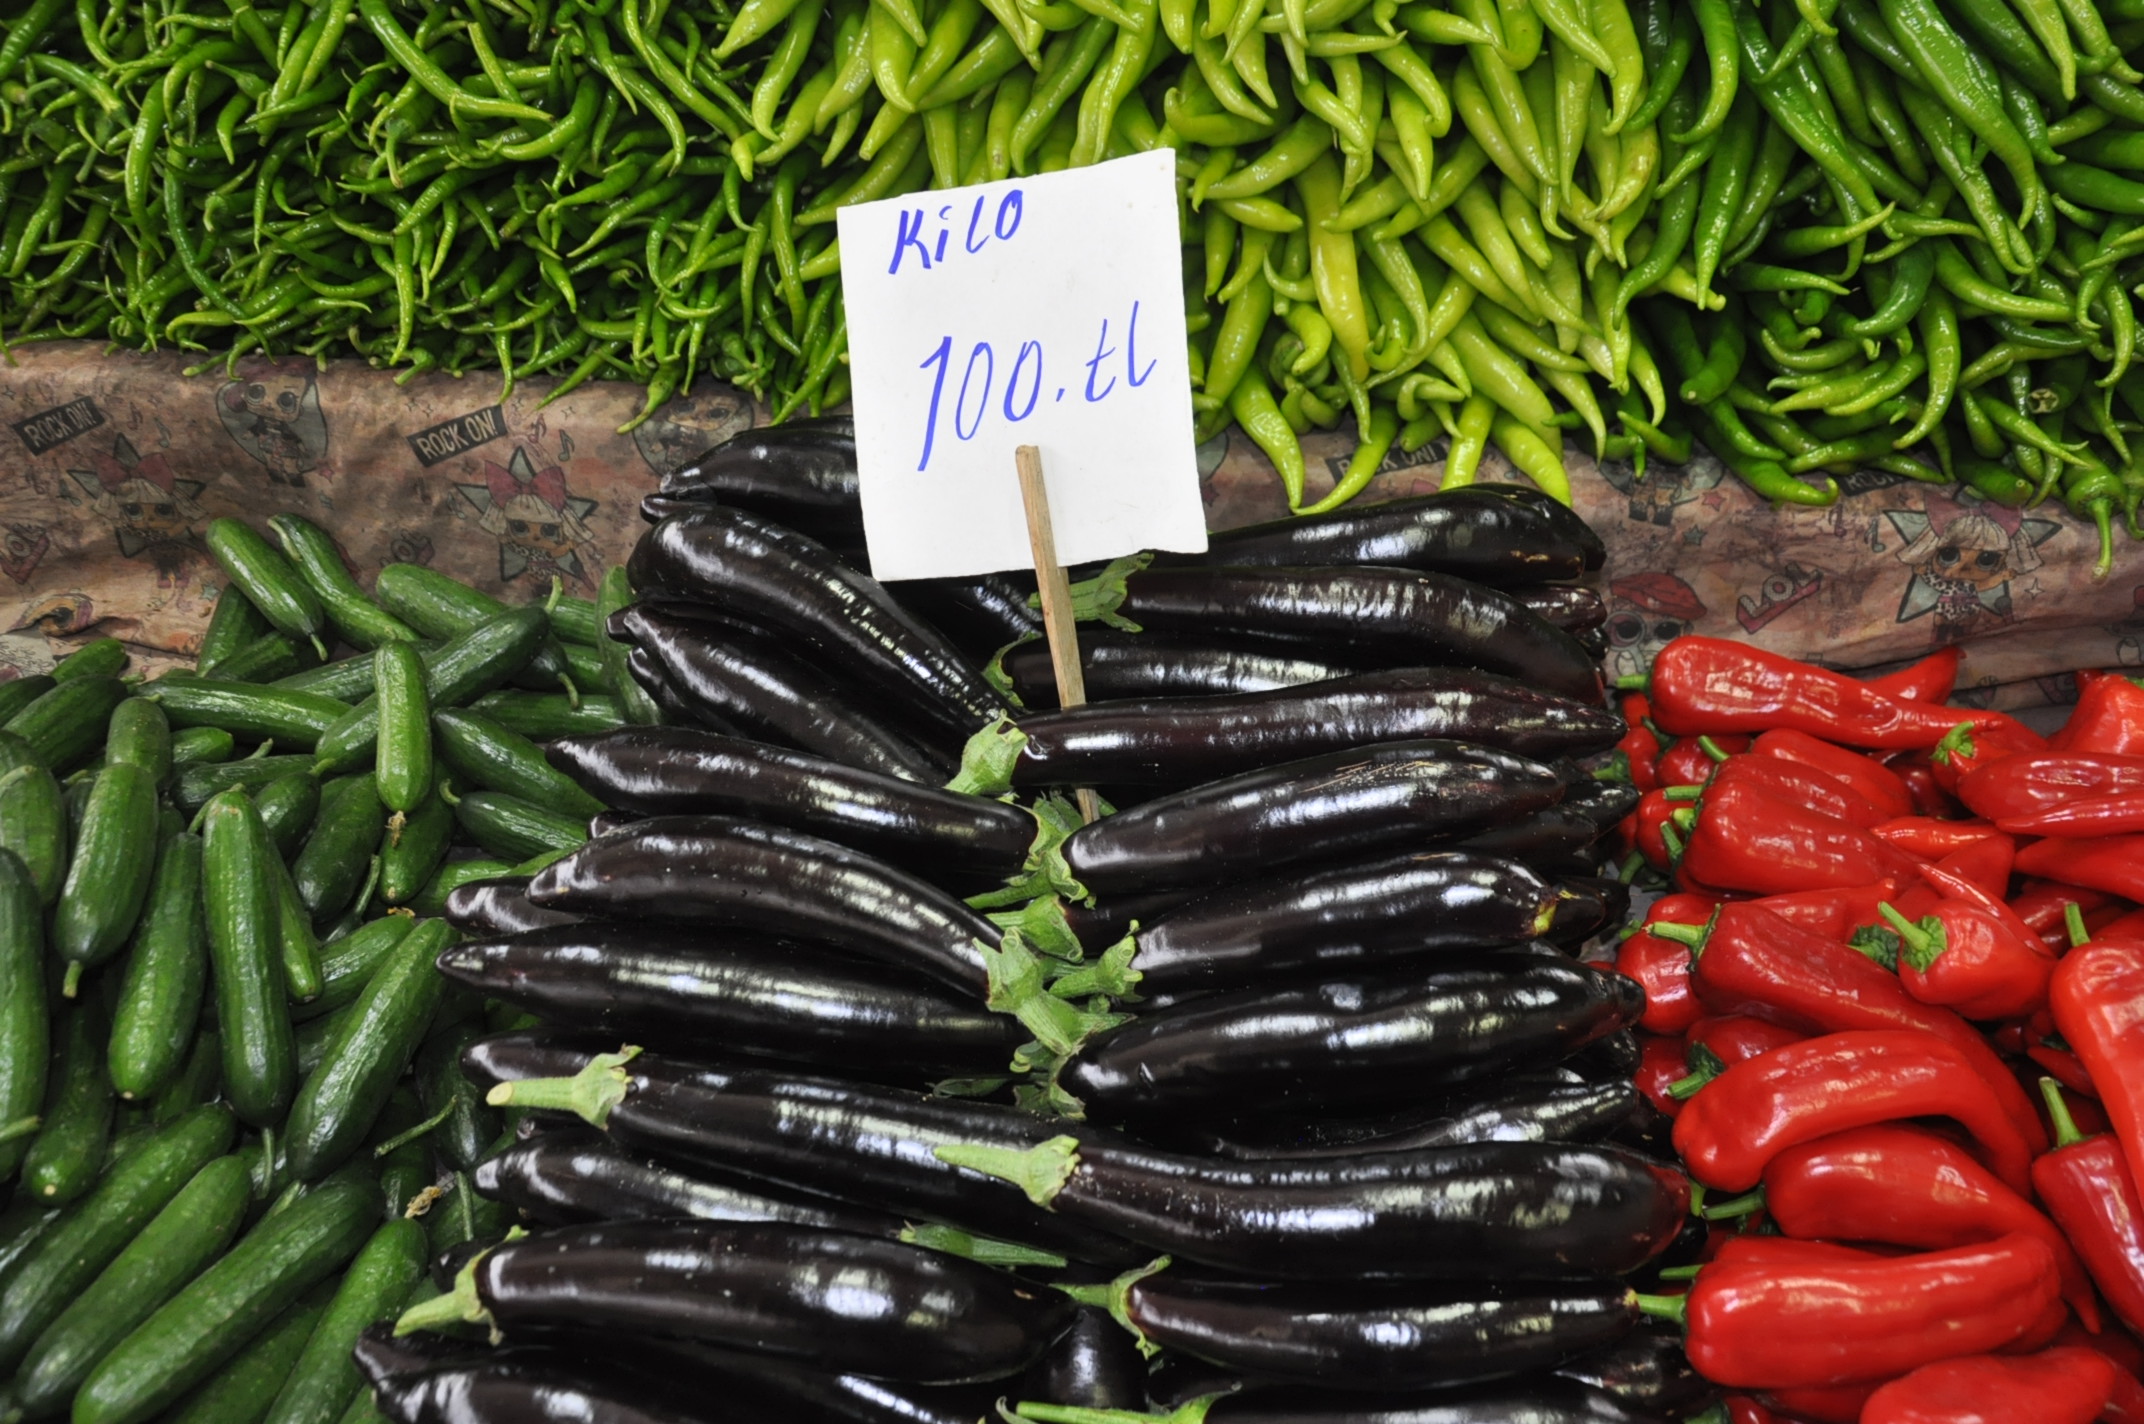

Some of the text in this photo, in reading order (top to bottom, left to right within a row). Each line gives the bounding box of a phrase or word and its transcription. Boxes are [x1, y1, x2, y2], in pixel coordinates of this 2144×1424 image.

[23, 401, 97, 448] ROCK ON!
[416, 409, 498, 460] ROCK ON!
[1336, 450, 1399, 476] RK
